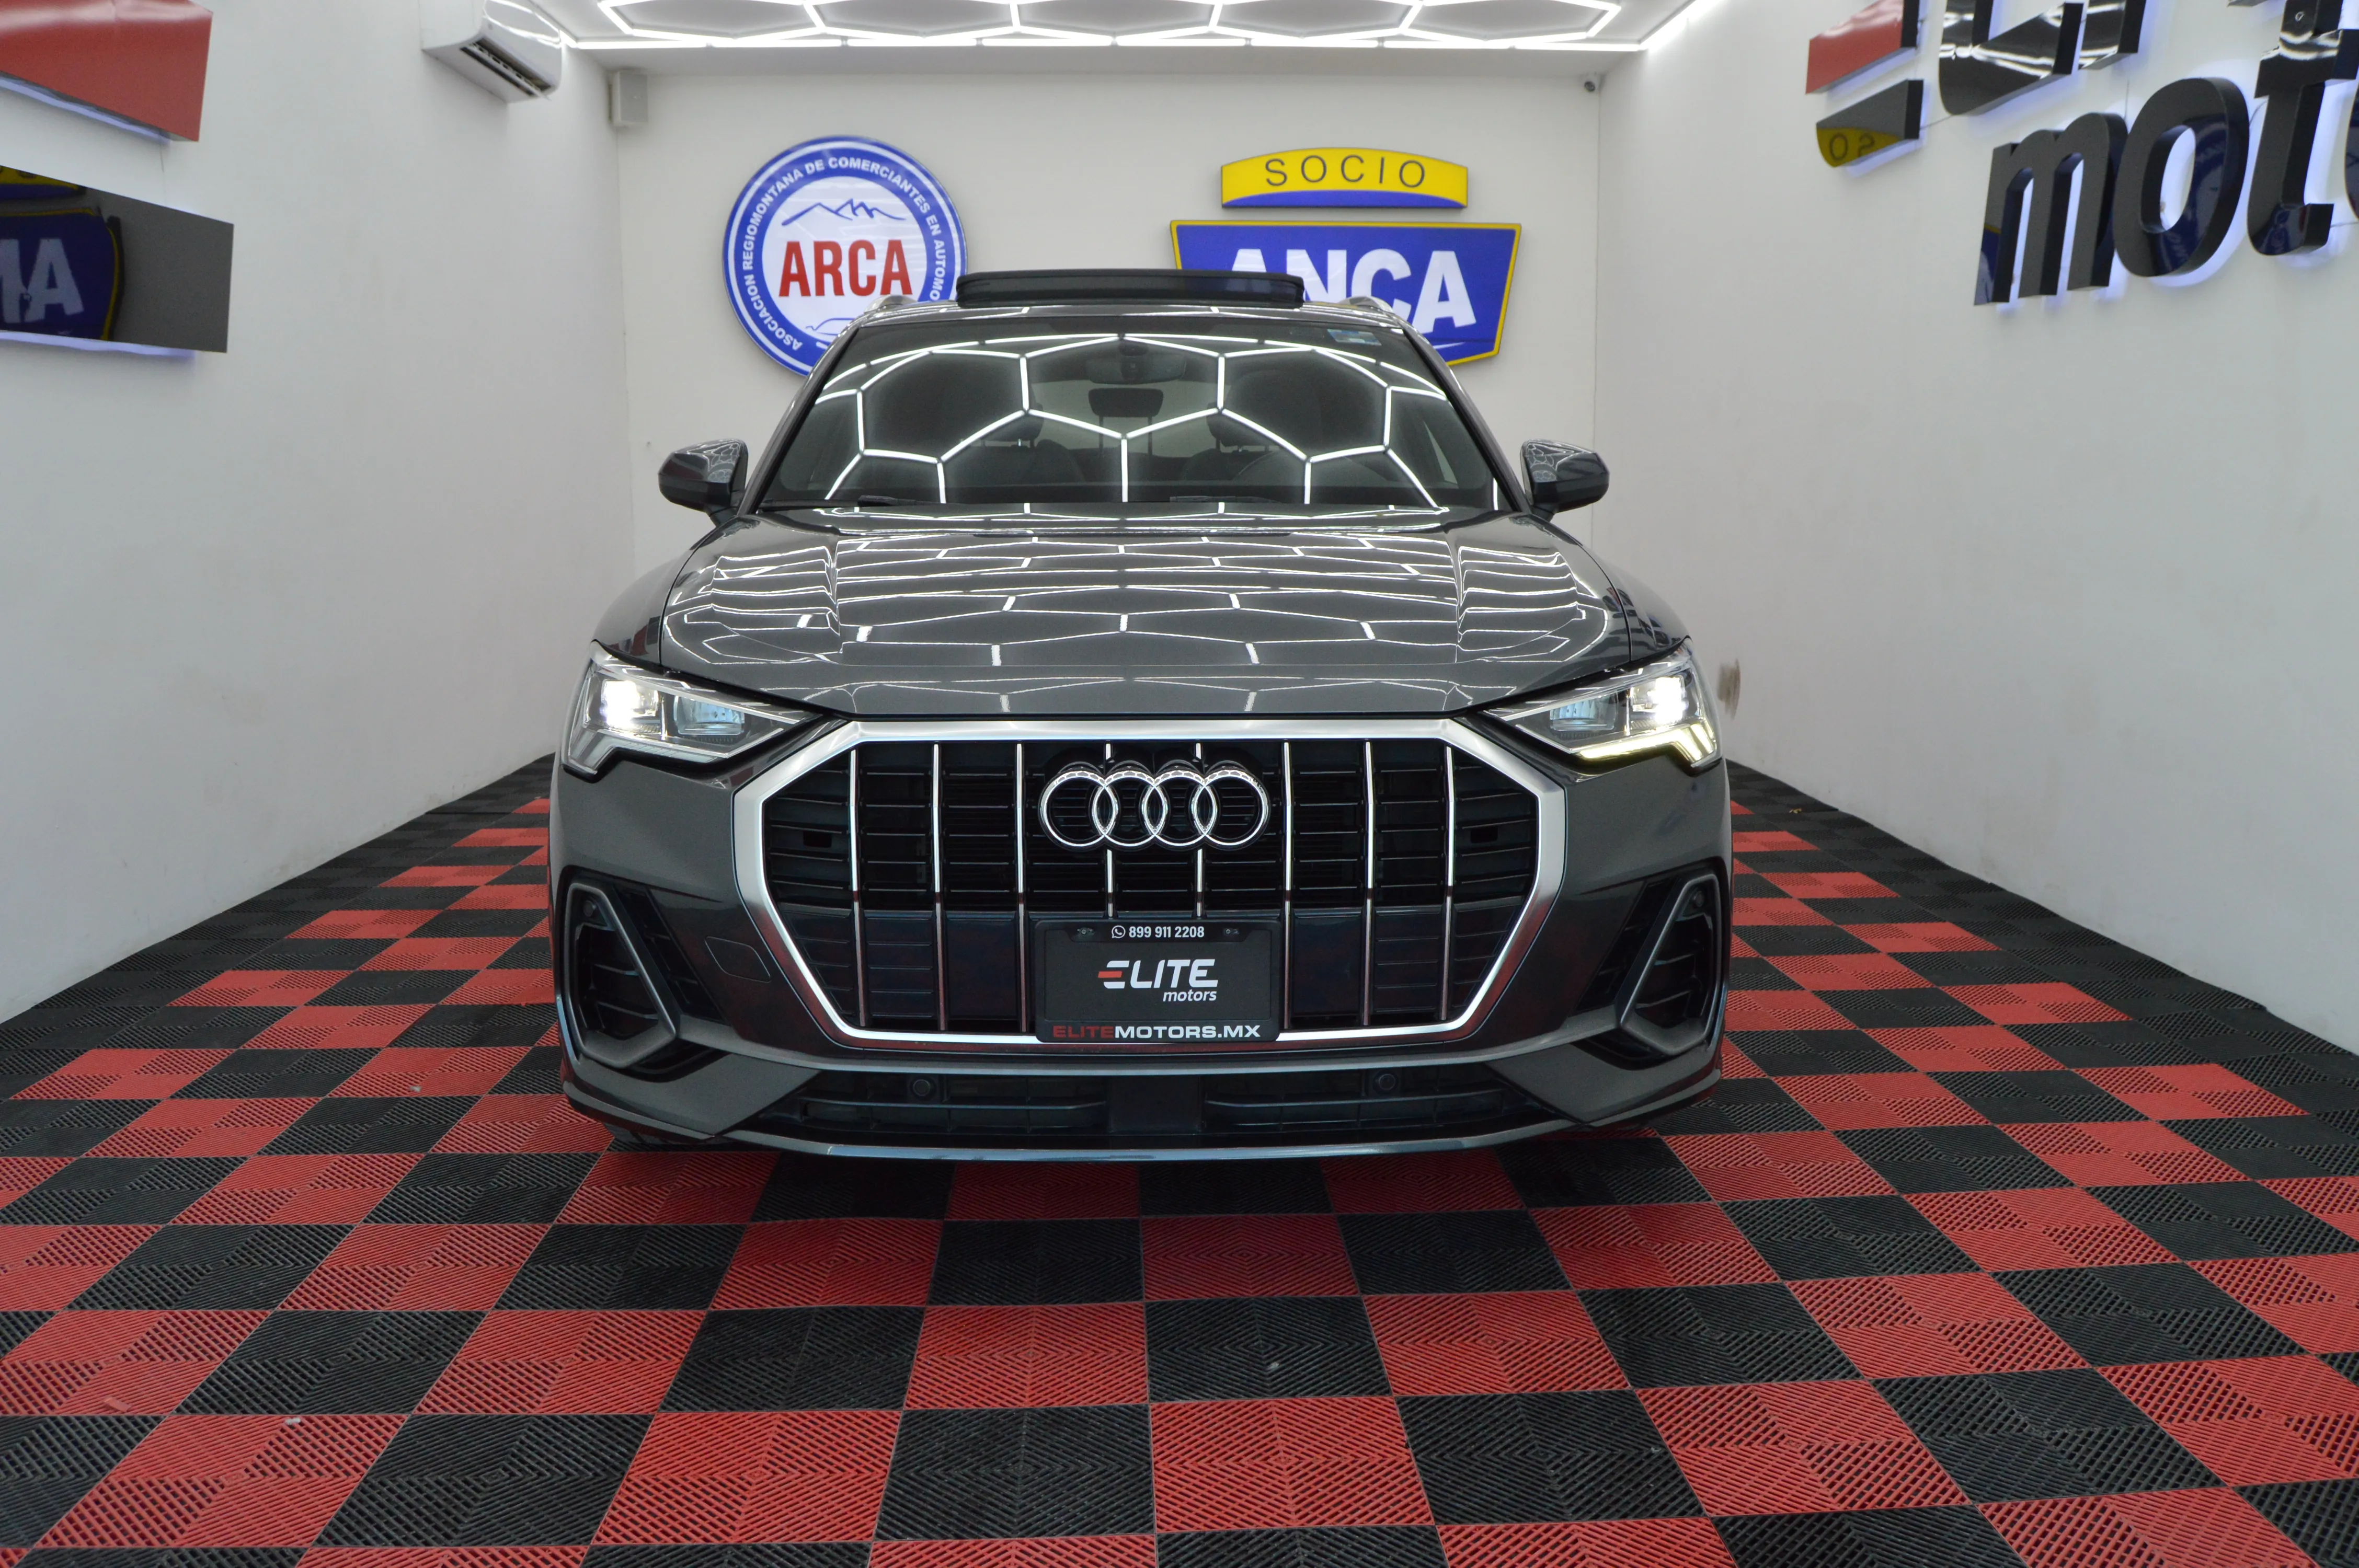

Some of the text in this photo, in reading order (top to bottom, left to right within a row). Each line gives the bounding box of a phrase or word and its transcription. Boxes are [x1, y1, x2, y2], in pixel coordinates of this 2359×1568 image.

[805, 159, 825, 176] DE
[1974, 0, 2359, 306] mot
[828, 157, 930, 214] COMERCIANTES
[1265, 155, 1425, 188] SOCIO
[742, 169, 804, 271] REGIOMONTANA
[925, 215, 941, 236] EN
[778, 239, 913, 297] ARCA
[1231, 248, 1476, 334] NCA
[745, 274, 803, 351] ASOCIACION
[1129, 926, 1205, 938] 899 911 2208
[1098, 959, 1219, 989] ELITE
[1163, 989, 1217, 1002] motors
[1053, 1025, 1261, 1039] ELITEMOTORS.MX
